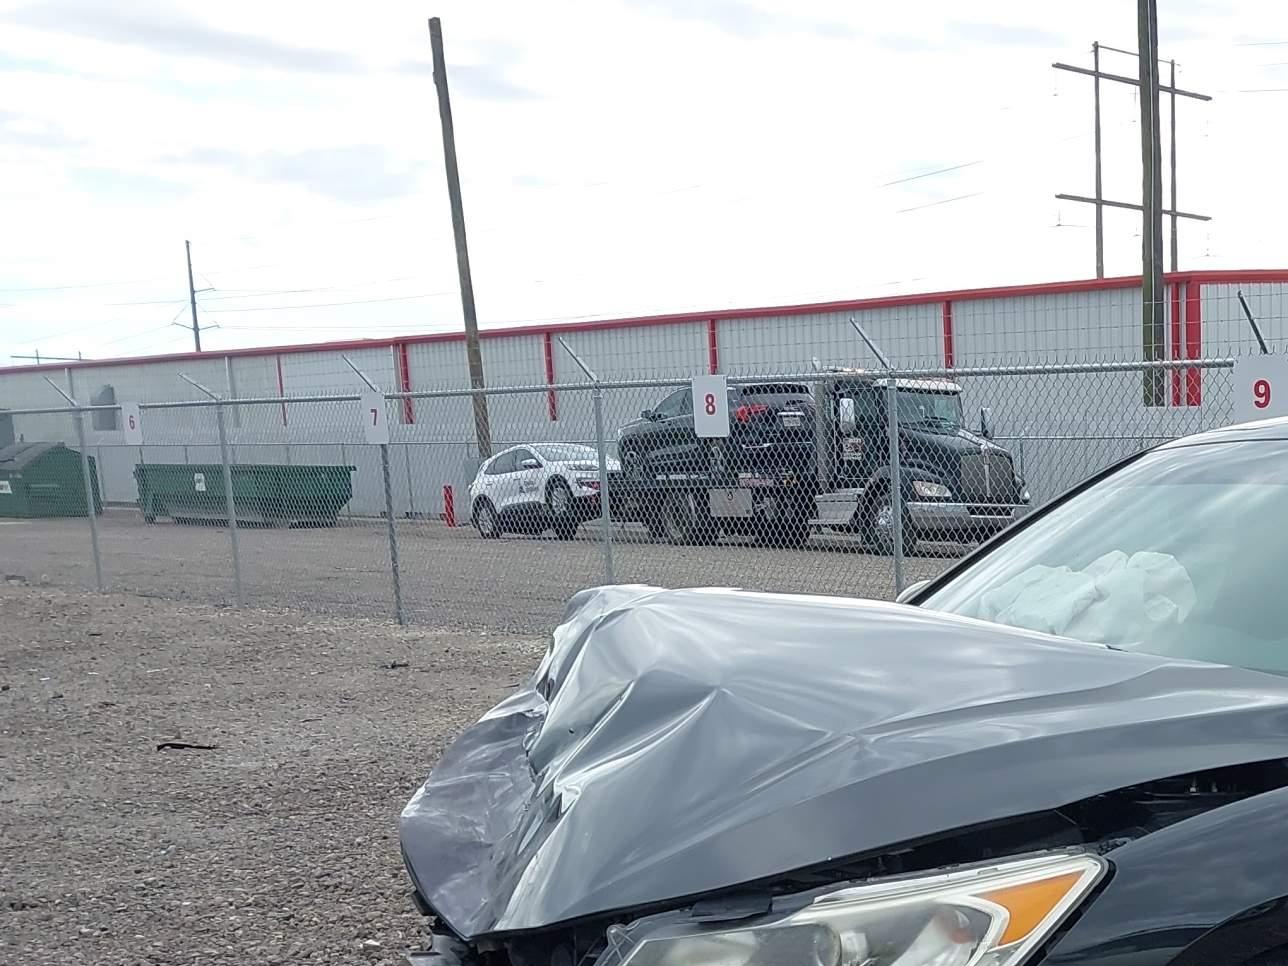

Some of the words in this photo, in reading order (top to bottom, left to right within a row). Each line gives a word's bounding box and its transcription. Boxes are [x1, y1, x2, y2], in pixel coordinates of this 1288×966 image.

[705, 393, 716, 415] 8
[1253, 379, 1271, 409] 9
[129, 415, 136, 430] 6
[370, 408, 378, 426] 7
